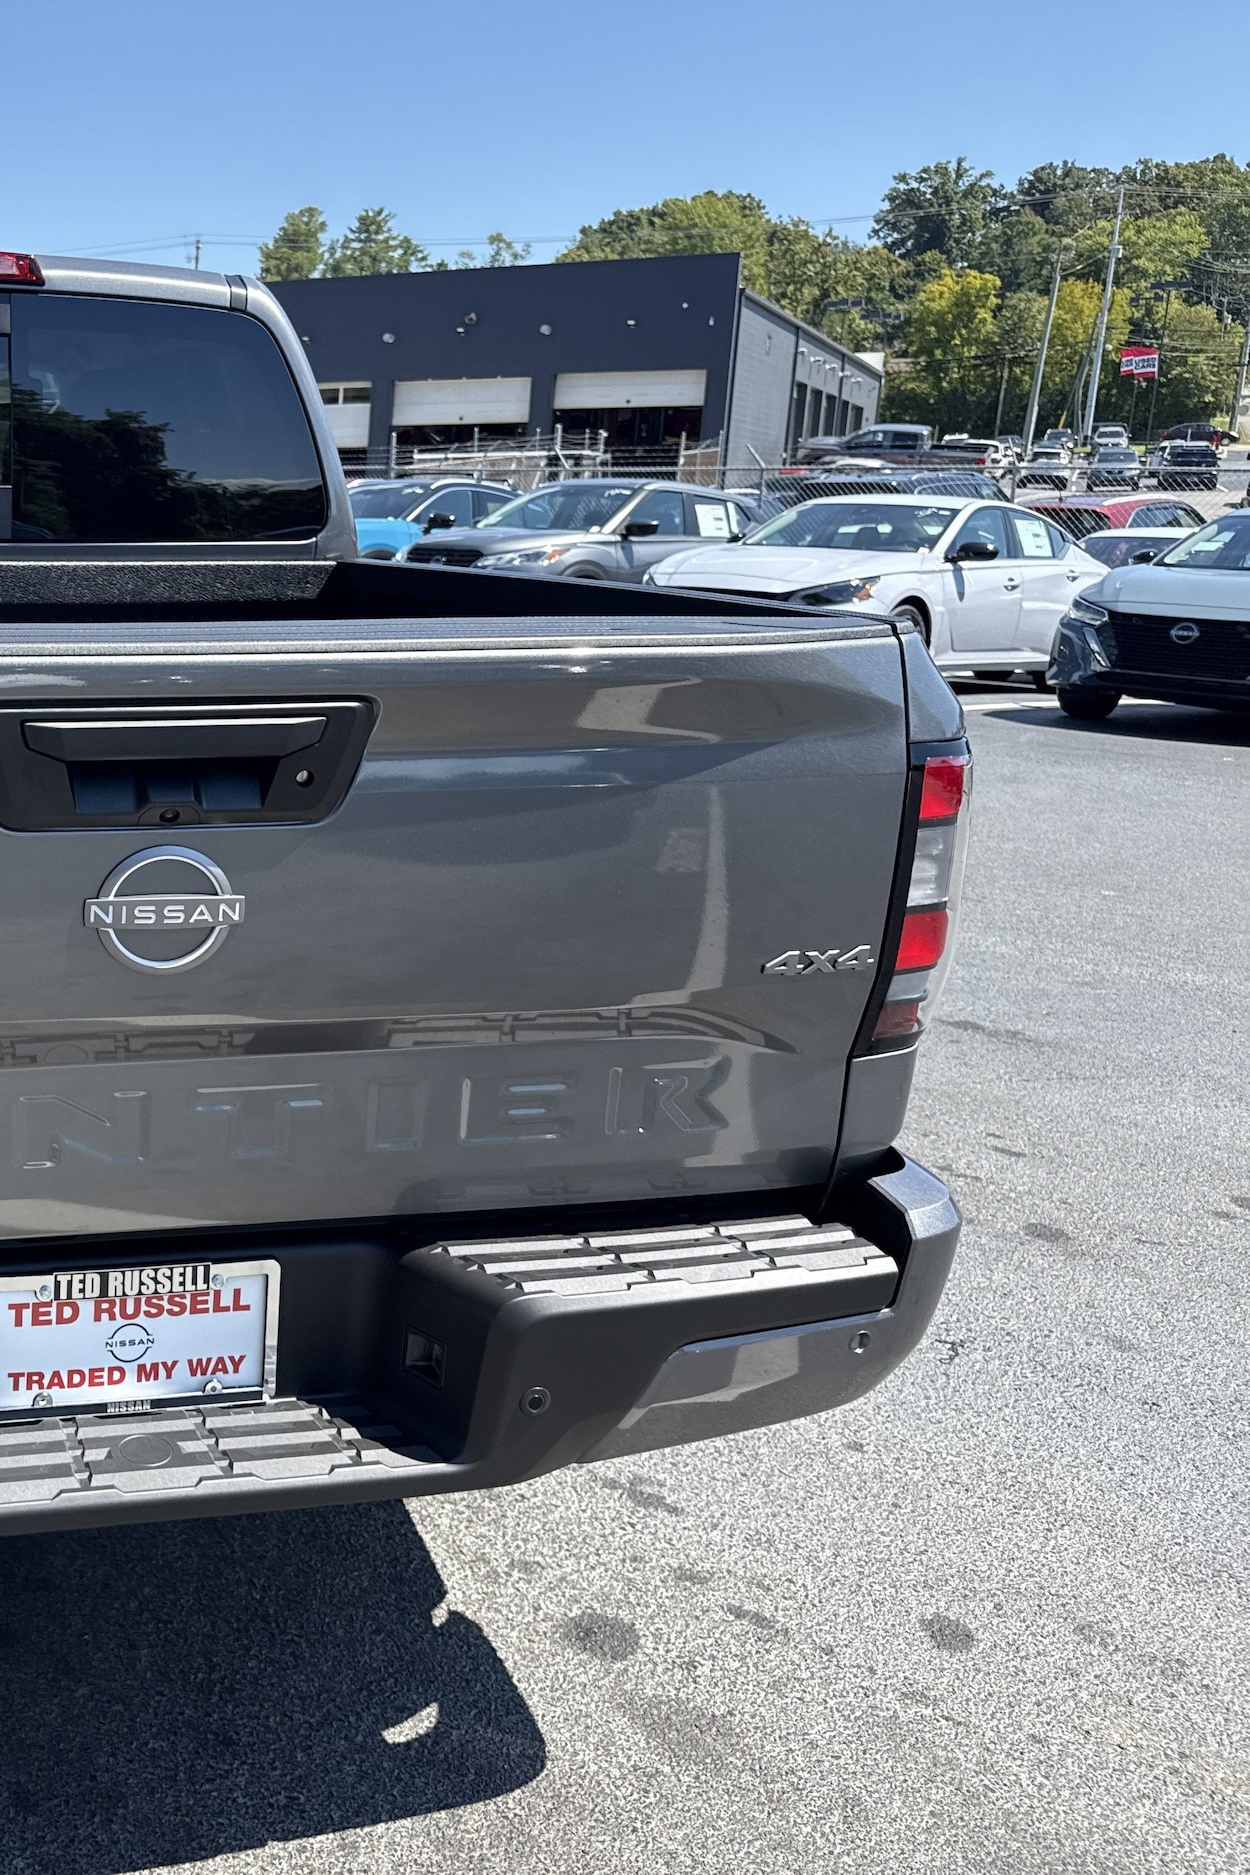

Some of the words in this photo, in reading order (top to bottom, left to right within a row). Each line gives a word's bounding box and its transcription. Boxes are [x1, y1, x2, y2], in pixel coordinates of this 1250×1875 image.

[1135, 357, 1156, 365] USED
[89, 902, 241, 925] NISSAN
[56, 1272, 100, 1300] TED
[108, 1264, 209, 1297] RUSSELL
[8, 1300, 80, 1328] TED
[93, 1288, 251, 1323] RUSSELL
[105, 1336, 155, 1349] NISSAN
[7, 1366, 126, 1392] TRADED
[136, 1360, 179, 1383] MY
[187, 1354, 247, 1378] WAY
[107, 1400, 151, 1413] NISSAN
